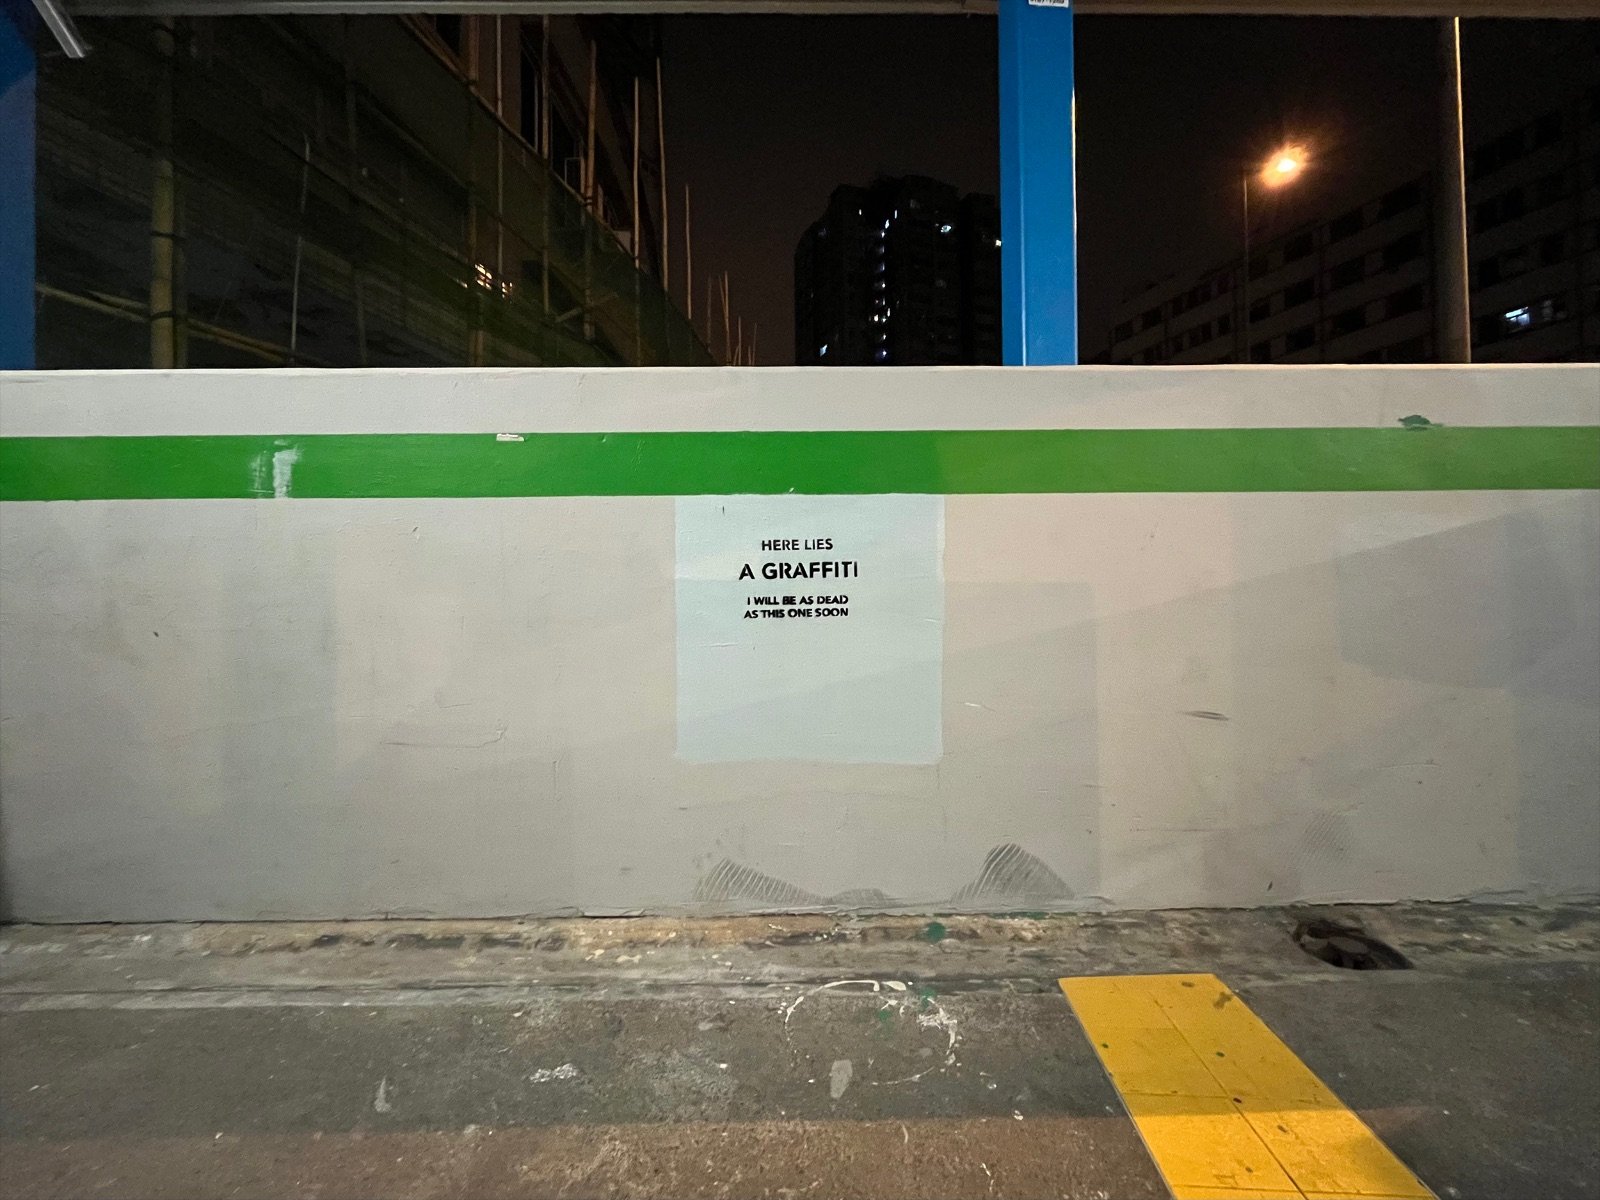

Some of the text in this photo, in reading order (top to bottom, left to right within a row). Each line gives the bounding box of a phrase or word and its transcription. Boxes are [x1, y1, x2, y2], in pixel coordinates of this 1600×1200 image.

[761, 538, 833, 551] HERE LIES
[738, 561, 858, 580] A GRAFFITI
[747, 595, 849, 605] I WILL BE AS DEAD
[744, 607, 849, 619] AS THIS ONE SOON
